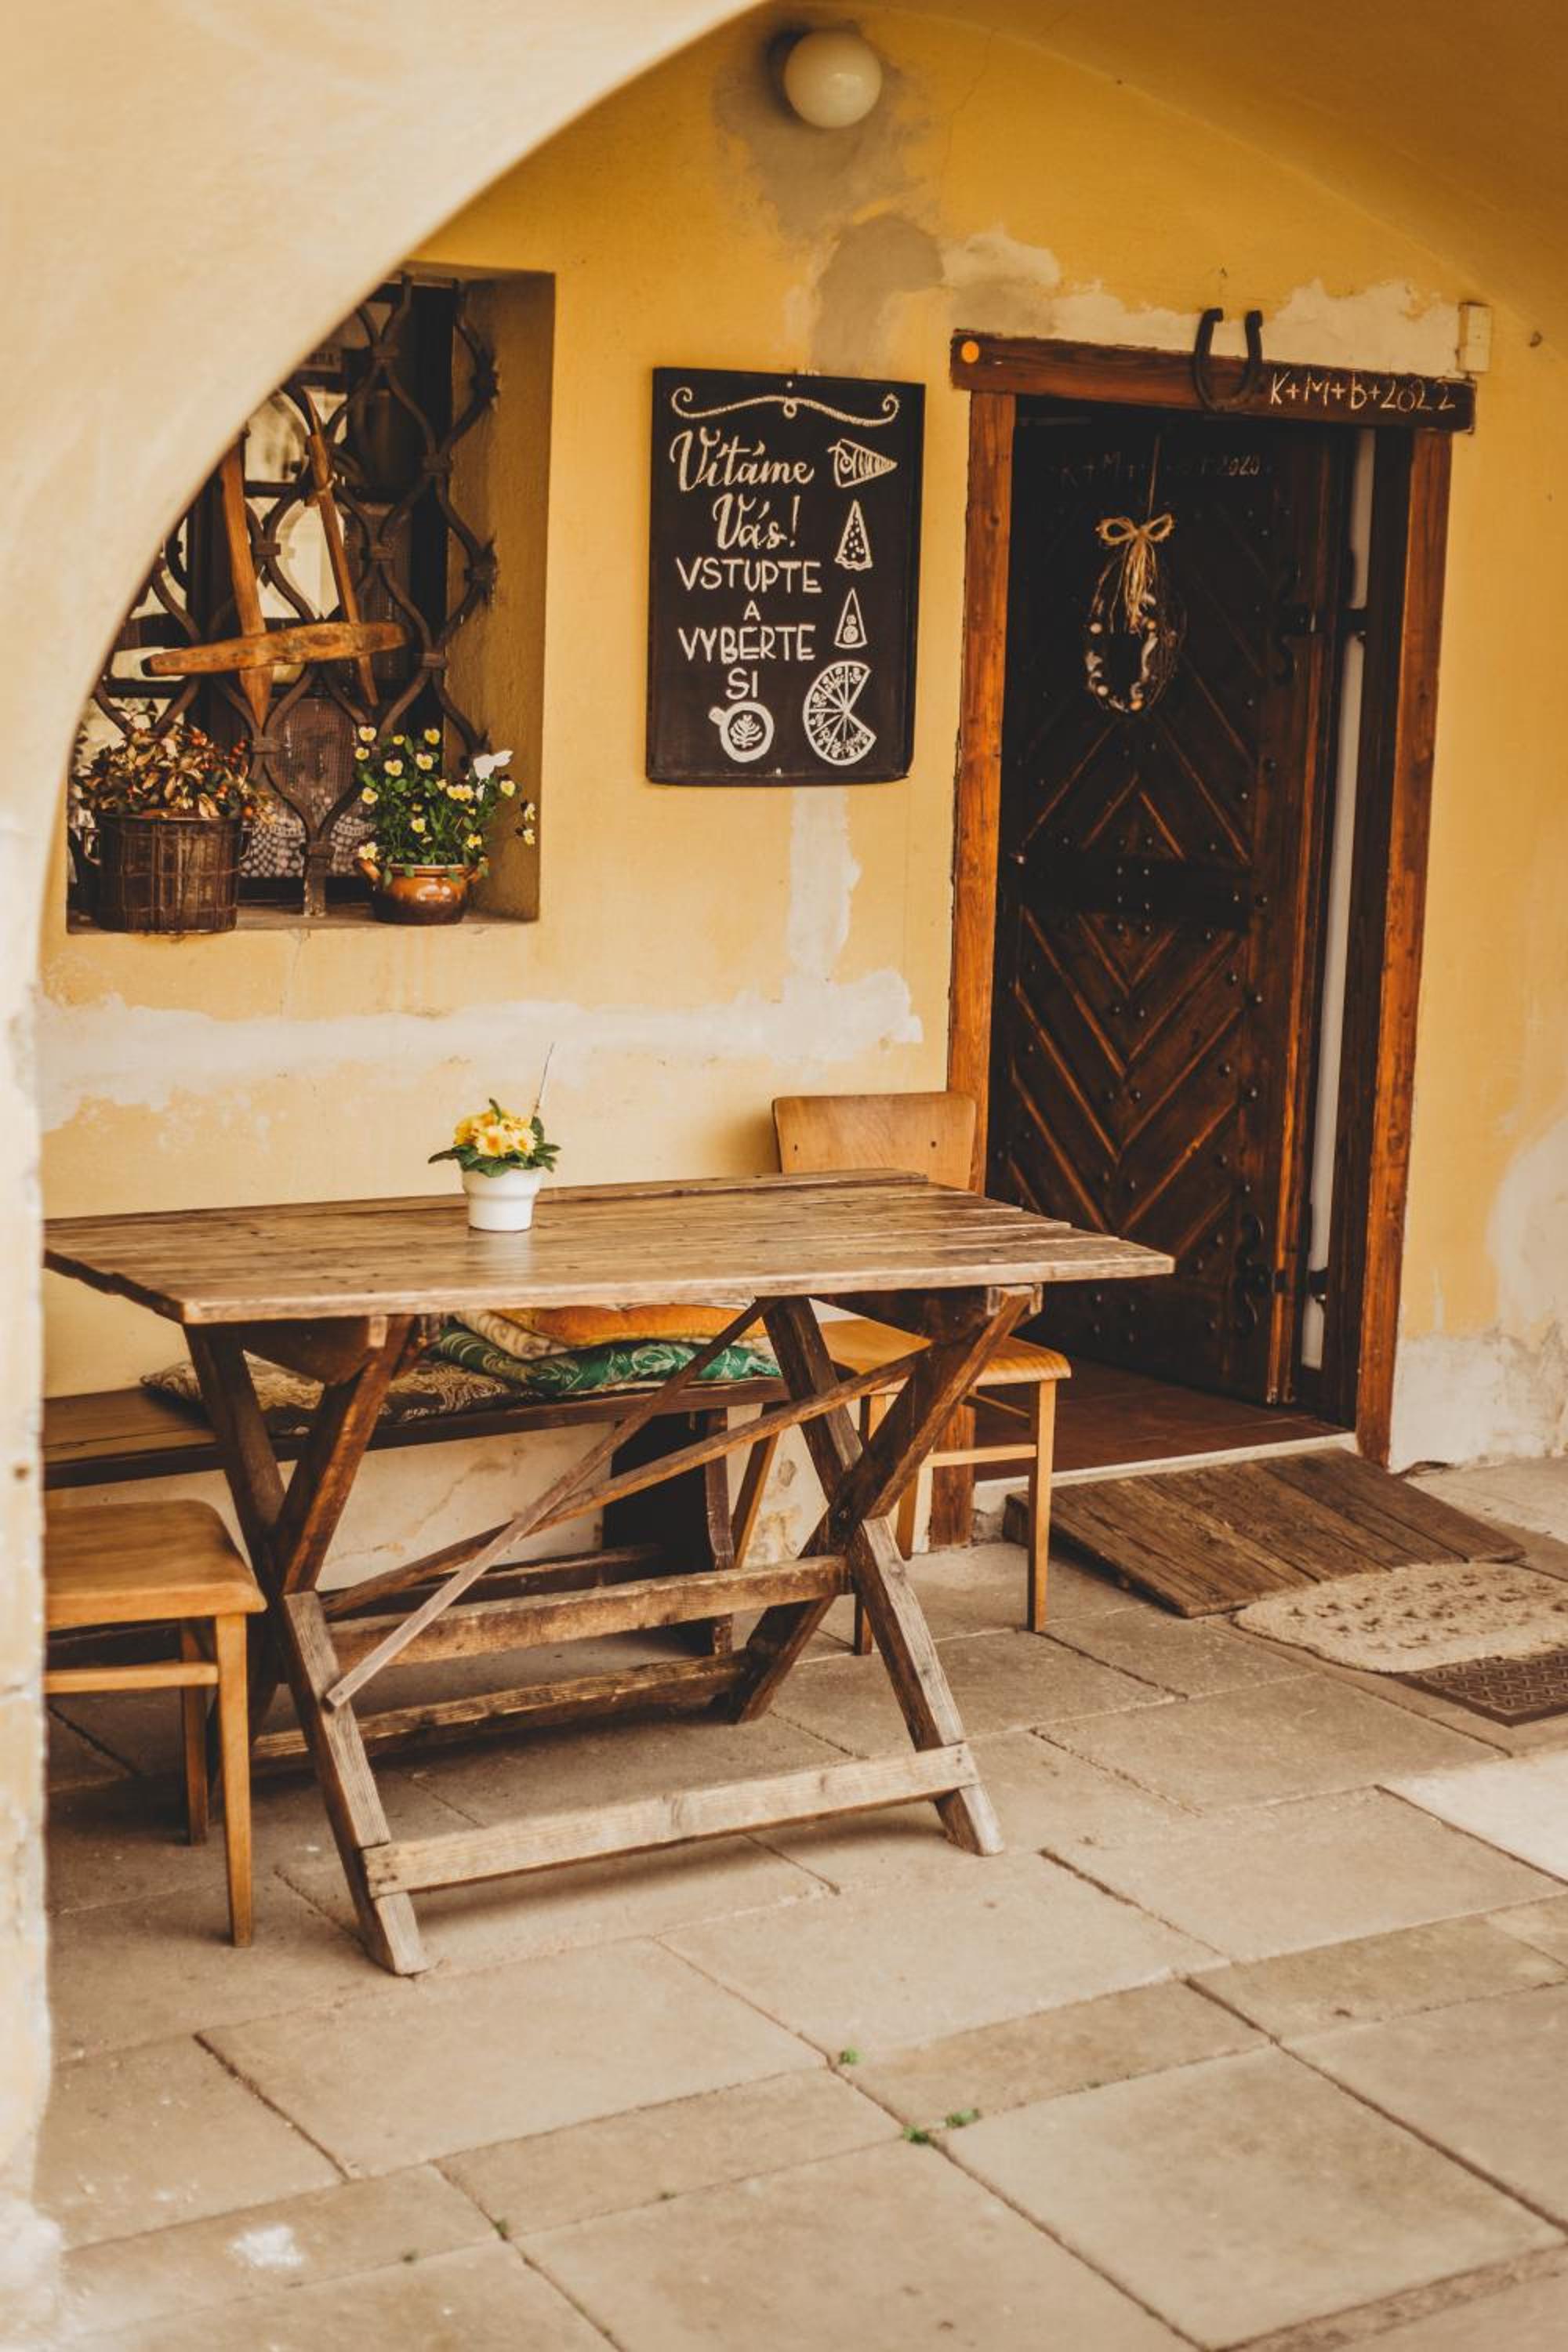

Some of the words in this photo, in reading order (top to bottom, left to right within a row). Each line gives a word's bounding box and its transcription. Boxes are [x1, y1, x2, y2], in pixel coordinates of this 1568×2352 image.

[669, 426, 815, 492] Vitáme
[712, 492, 800, 550] Vás!
[675, 556, 822, 593] VSTUPTE
[742, 599, 761, 622] A
[677, 622, 817, 665] VYBERTE
[724, 666, 759, 701] SI
